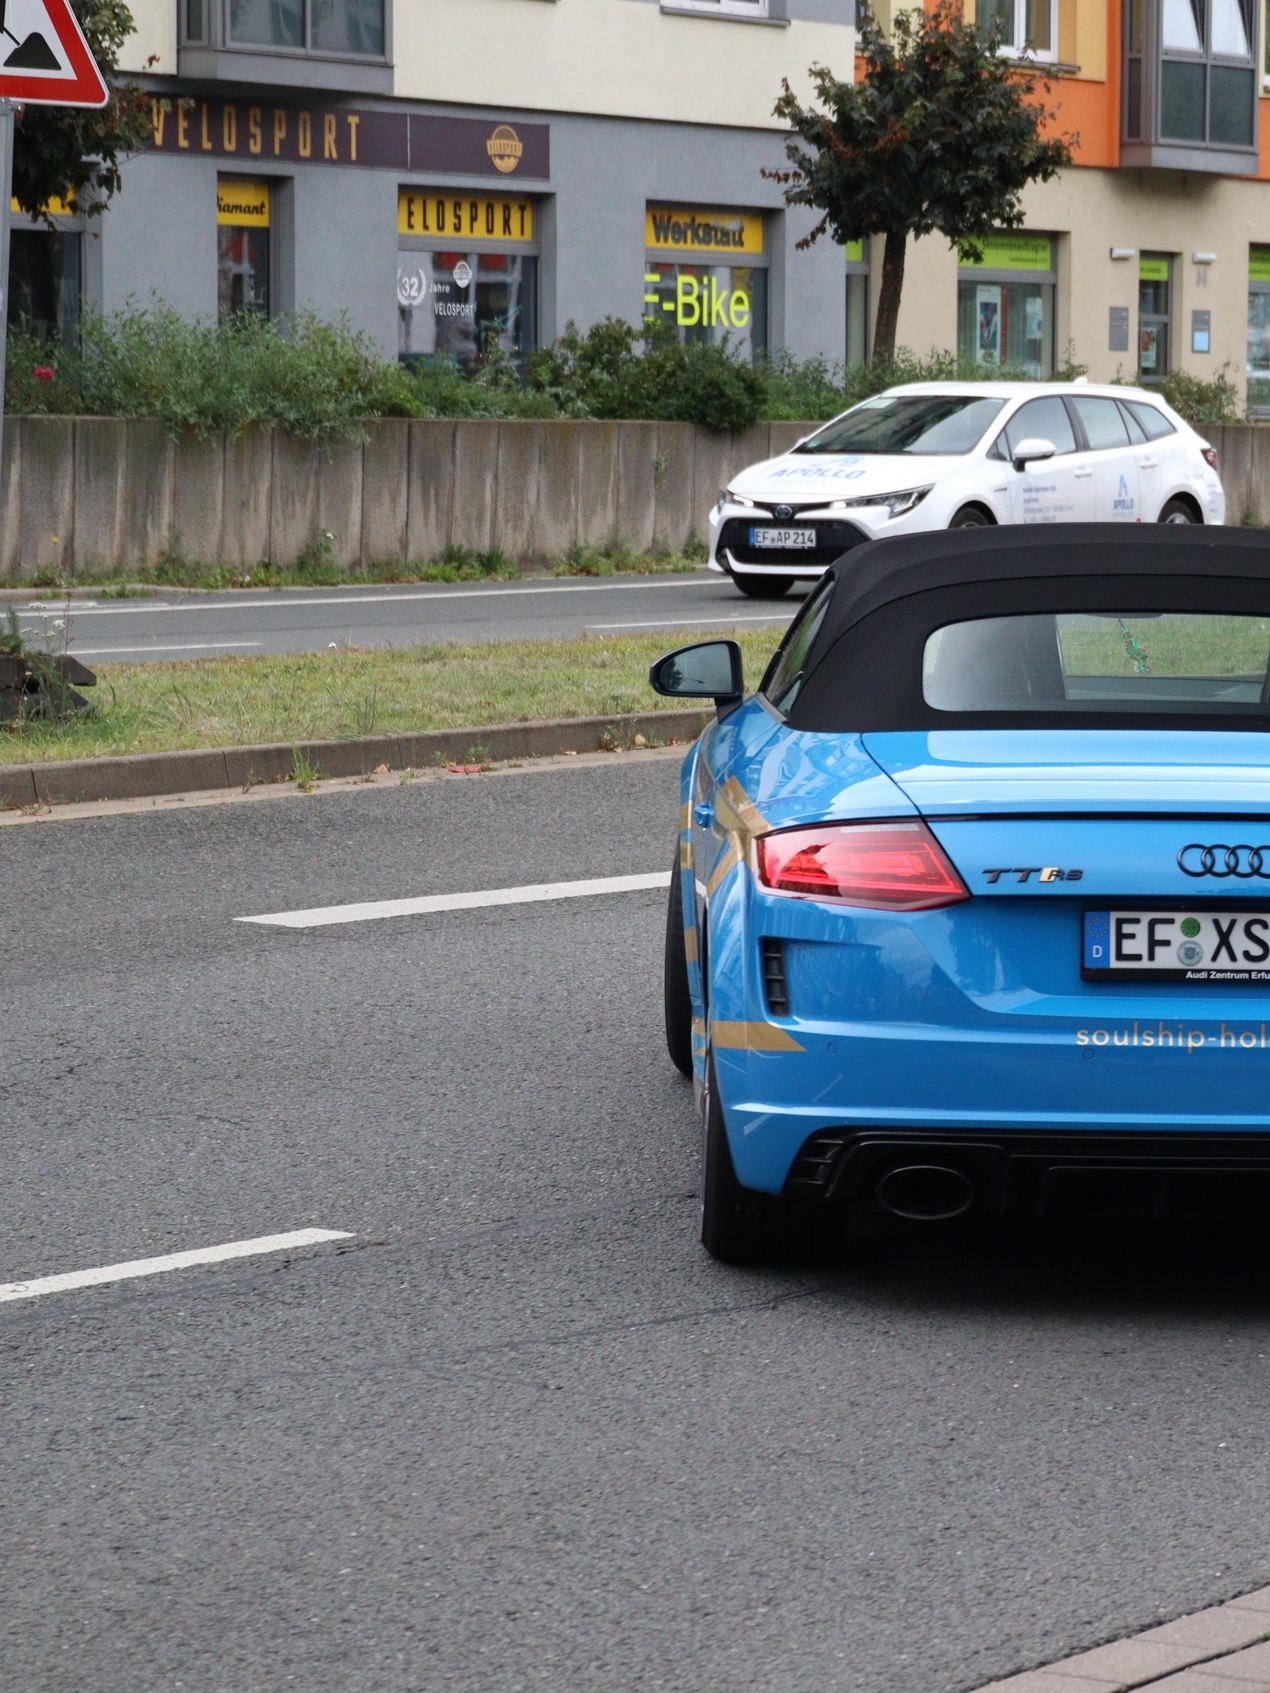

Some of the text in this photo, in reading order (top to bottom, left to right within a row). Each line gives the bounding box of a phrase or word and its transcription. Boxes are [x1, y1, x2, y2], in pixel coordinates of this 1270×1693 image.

[152, 97, 360, 161] VELOSPORT
[217, 194, 266, 215] iamant
[652, 213, 744, 248] Werkstatt
[402, 277, 450, 297] 32 Jahre
[434, 302, 475, 316] VELOSPORT
[767, 468, 867, 480] APOLLO
[1113, 499, 1134, 510] APOLLO
[755, 531, 814, 545] EF AP 214
[1092, 945, 1103, 958] D
[1115, 917, 1175, 962] EF
[1210, 918, 1270, 963] XS
[1185, 970, 1208, 979] Audi
[1209, 971, 1249, 980] Zentrum
